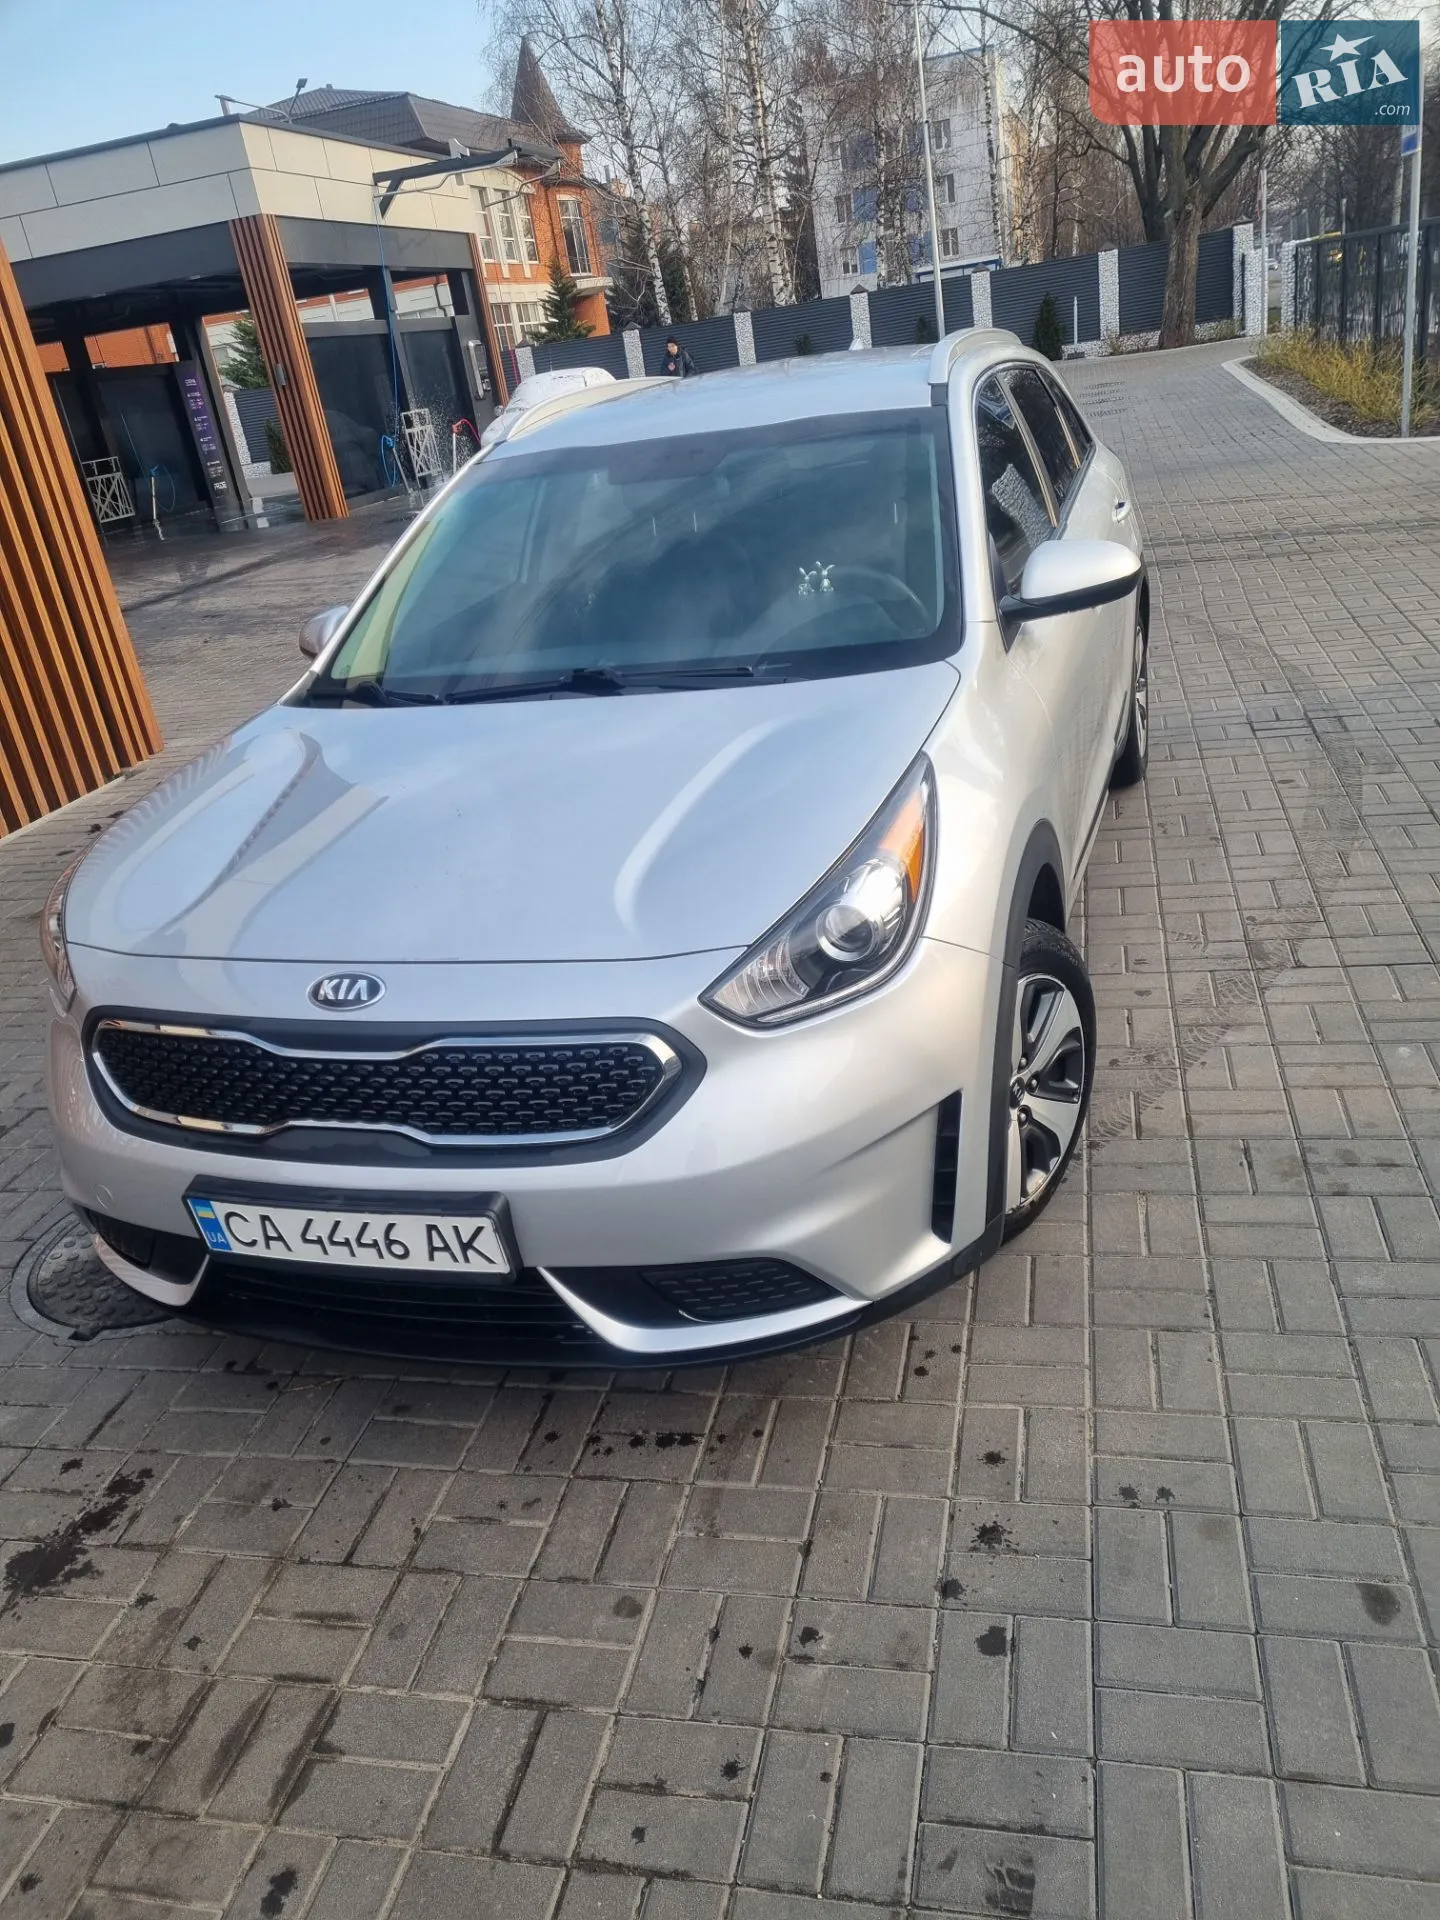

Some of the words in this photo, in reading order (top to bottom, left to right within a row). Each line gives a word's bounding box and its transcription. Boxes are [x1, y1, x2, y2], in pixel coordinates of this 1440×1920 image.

[317, 978, 368, 1001] KIA
[206, 1231, 228, 1245] UA
[223, 1211, 294, 1253] CA
[300, 1217, 411, 1261] 4446
[424, 1223, 498, 1265] AK
